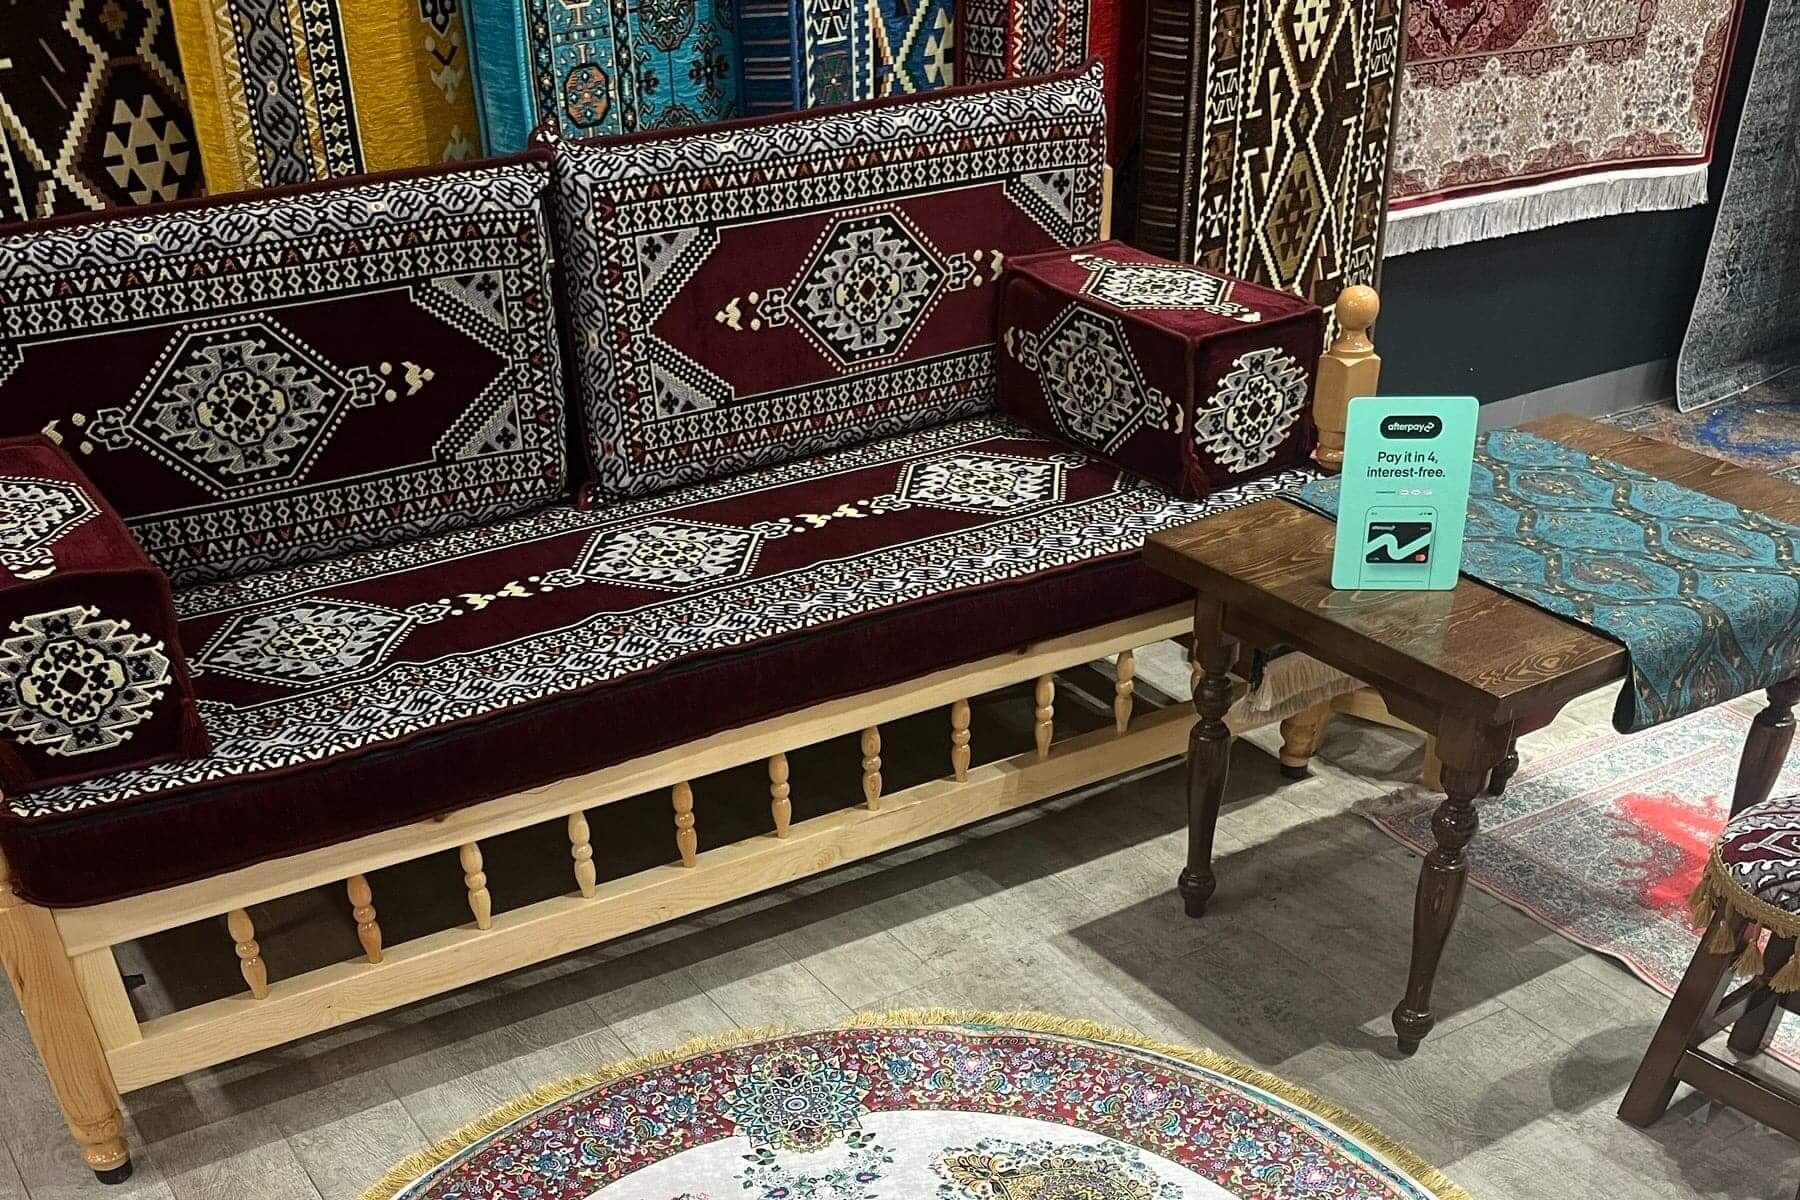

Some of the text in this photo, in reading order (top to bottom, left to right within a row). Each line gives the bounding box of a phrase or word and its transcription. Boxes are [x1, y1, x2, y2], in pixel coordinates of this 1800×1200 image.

[1387, 422, 1424, 432] afterpay
[1377, 451, 1438, 465] Pay it in 4,
[1366, 466, 1446, 477] interest-free.
